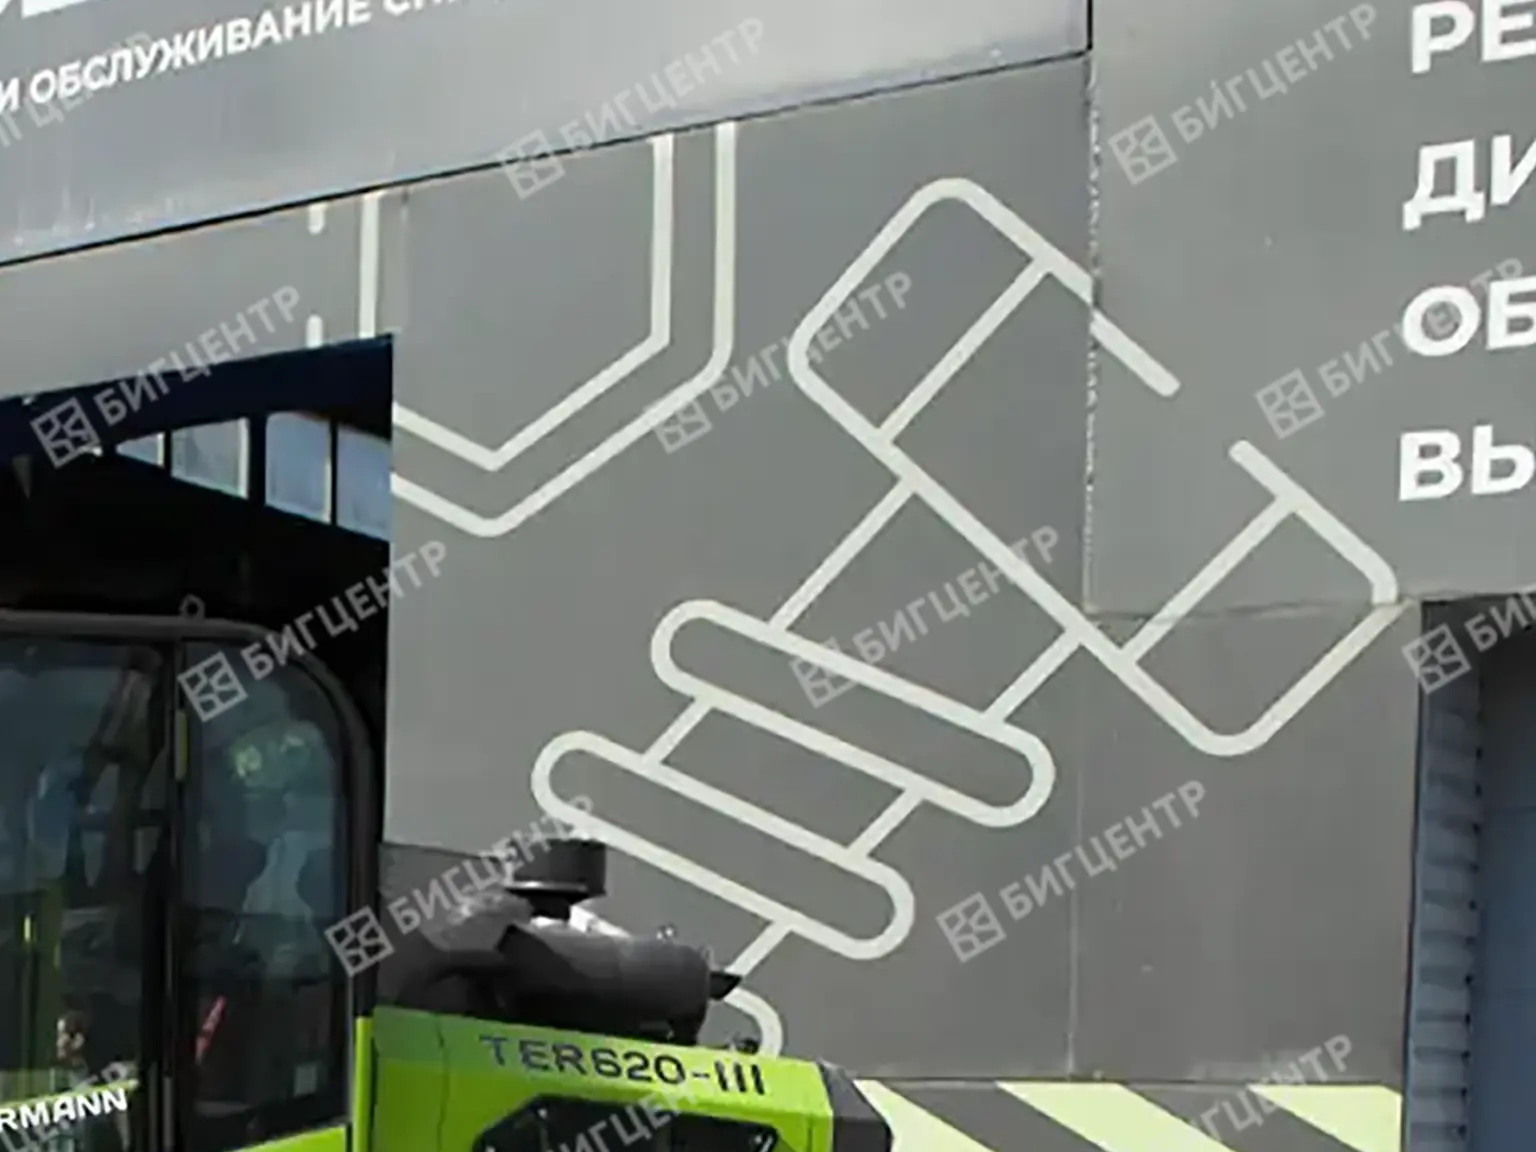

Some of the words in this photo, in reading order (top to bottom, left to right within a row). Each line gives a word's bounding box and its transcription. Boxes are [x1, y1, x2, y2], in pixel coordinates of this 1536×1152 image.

[29, 0, 372, 105] ОБСЛУЖИВАНИЕ
[1401, 274, 1536, 357] ОБ
[479, 1034, 765, 1096] TER620-III
